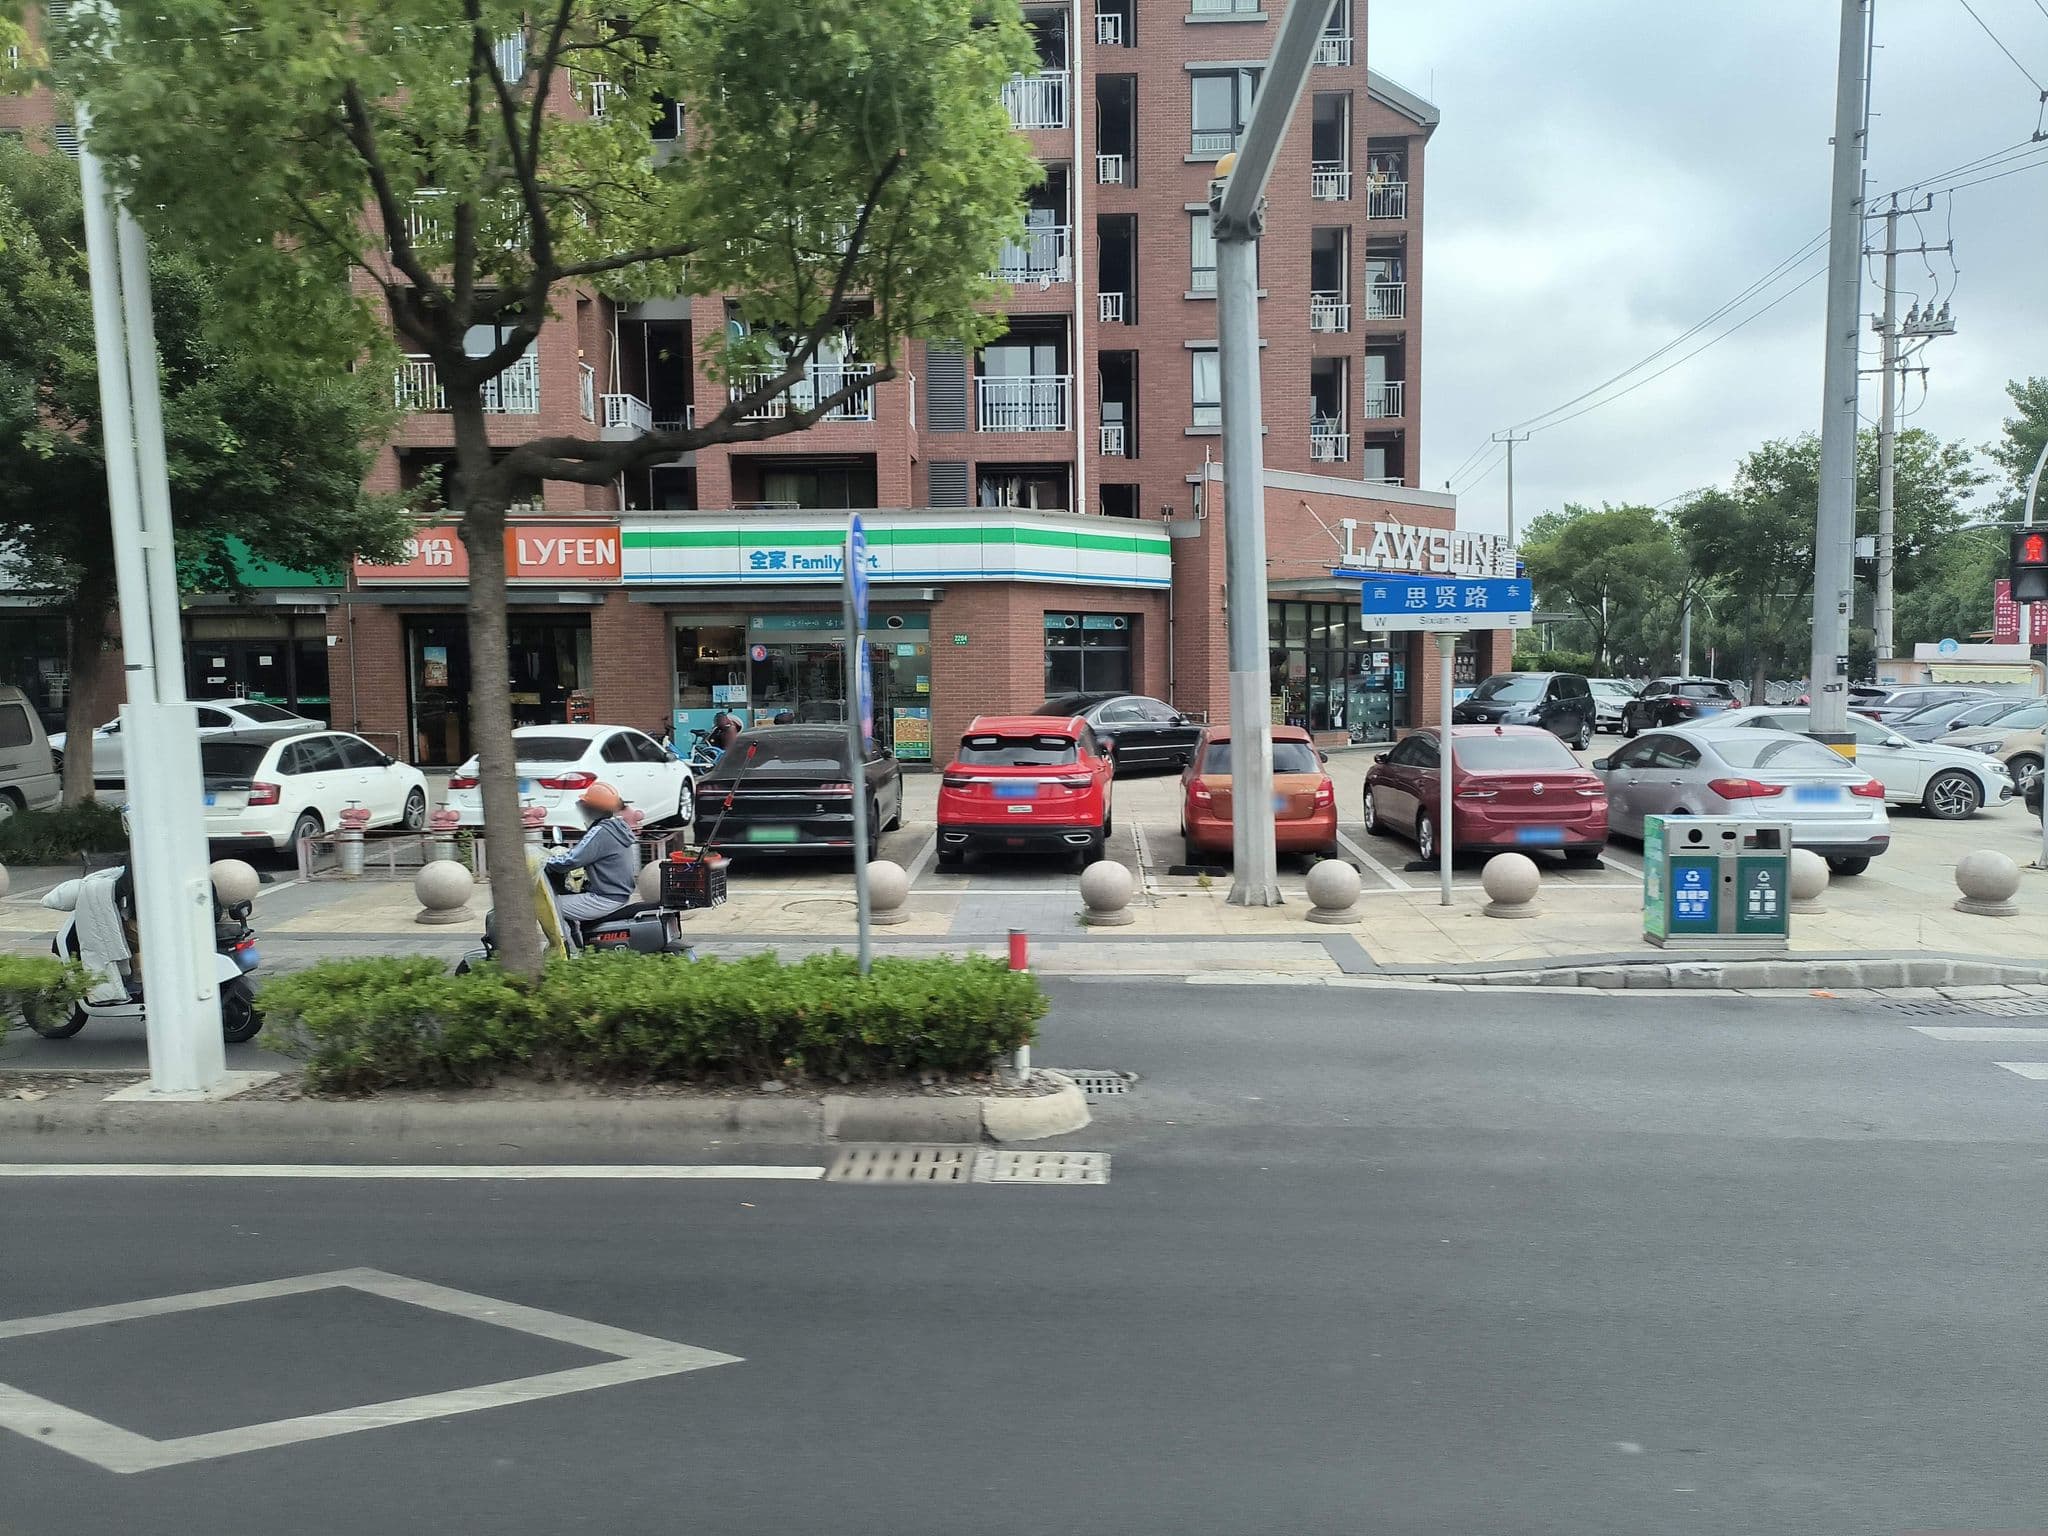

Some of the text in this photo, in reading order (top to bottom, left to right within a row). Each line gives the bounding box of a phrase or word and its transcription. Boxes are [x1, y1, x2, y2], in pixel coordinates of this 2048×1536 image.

[518, 538, 616, 565] LYFEN
[1340, 518, 1496, 575] LAWSON
[749, 550, 787, 570] 全家
[1373, 585, 1520, 609] 西 思贤路 东
[1374, 617, 1387, 626] W
[1508, 615, 1518, 625] E
